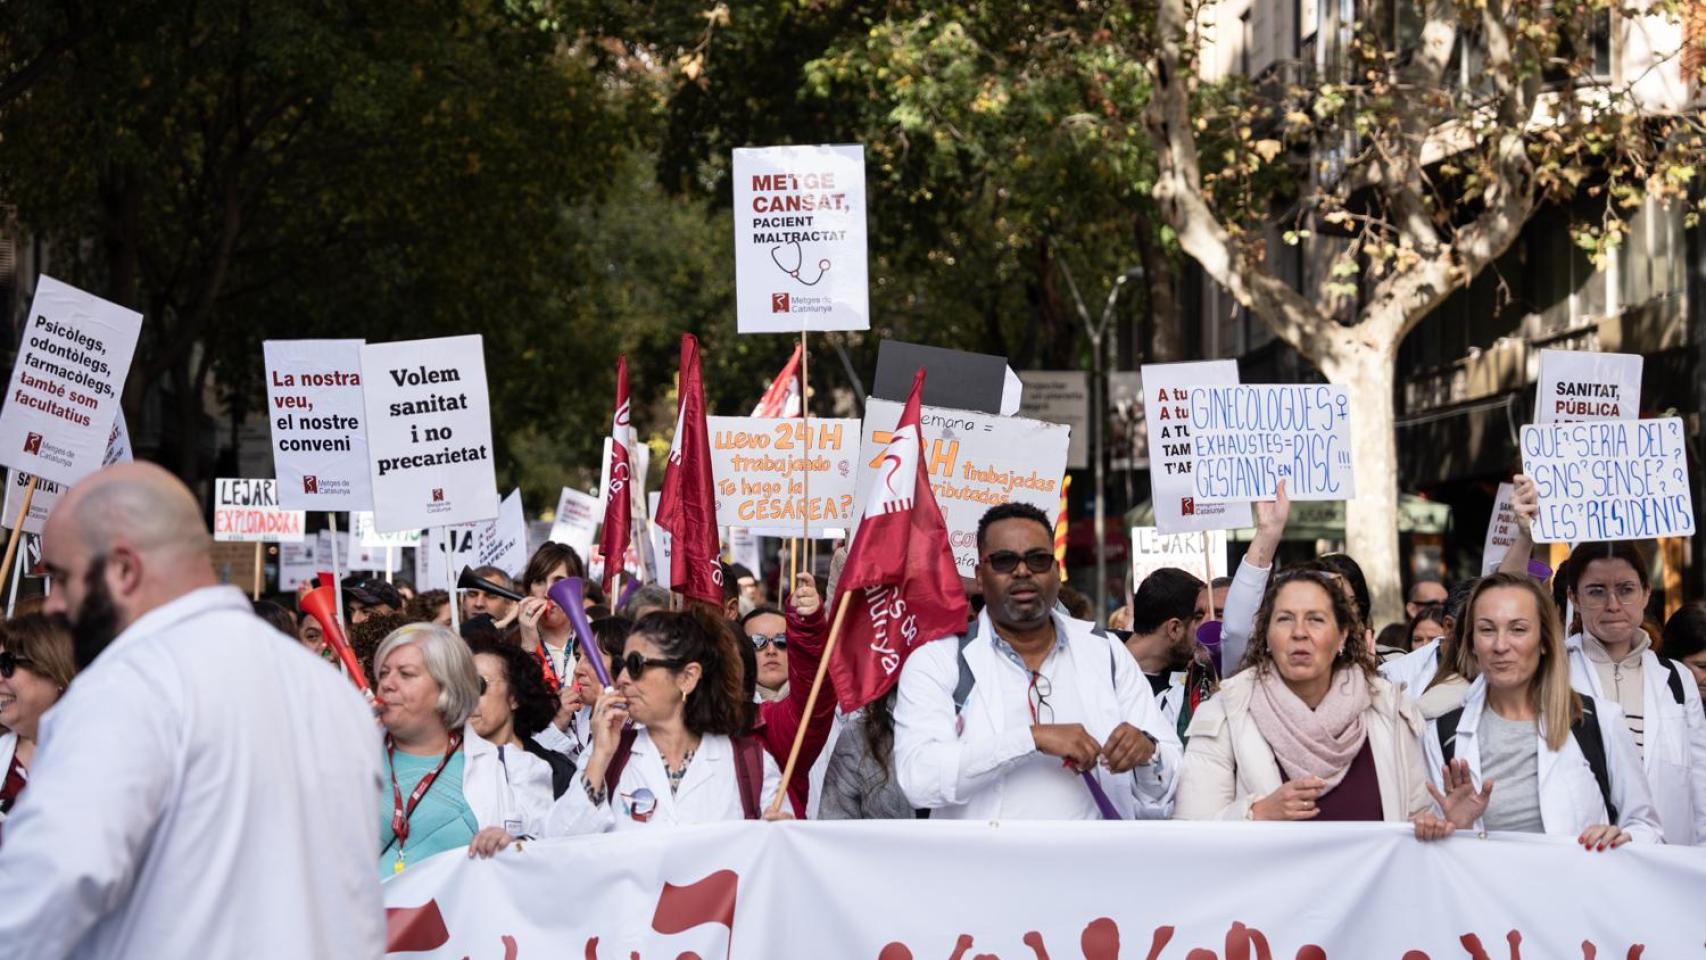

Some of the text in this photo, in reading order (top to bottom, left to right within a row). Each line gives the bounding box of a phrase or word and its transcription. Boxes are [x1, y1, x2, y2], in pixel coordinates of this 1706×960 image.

[752, 173, 835, 191] METGE
[753, 194, 850, 214] CANSAT,
[753, 216, 814, 228] PACIENT
[753, 231, 847, 244] MALTRACTAT
[35, 315, 106, 355] Psicòlegs,
[30, 336, 111, 377] odontòlegs,
[24, 353, 115, 398] farmacòlegs,
[272, 370, 360, 387] La nostra
[389, 365, 460, 387] Volem
[20, 371, 98, 409] també som
[1158, 388, 1169, 402] A
[1556, 381, 1621, 401] SANITAT,
[15, 390, 92, 427] facultatius
[274, 395, 313, 411] veu,
[389, 393, 467, 417] sanitat
[1555, 397, 1620, 416] PÚBLICA
[277, 414, 359, 430] el nostre
[921, 414, 975, 431] emana
[1160, 407, 1170, 420] A
[411, 425, 452, 443] i no
[1161, 426, 1171, 439] A
[1573, 423, 1629, 458] SERIA
[1638, 422, 1669, 458] DEL
[279, 435, 351, 451] conveni
[1162, 444, 1191, 457] TAM
[1195, 433, 1283, 456] EXHAUSTES
[377, 445, 487, 475] precarietat
[731, 454, 831, 478] trabajando
[1195, 456, 1277, 498] GESTANTS
[1278, 464, 1292, 477] EN
[1293, 434, 1340, 494] RISC
[318, 479, 340, 489] Metges
[962, 461, 1056, 492] trabajadas
[1534, 461, 1584, 499] SNS
[718, 478, 803, 498] Te hago la
[932, 482, 1009, 505] ributadas
[1587, 494, 1691, 539] RESIDENTS
